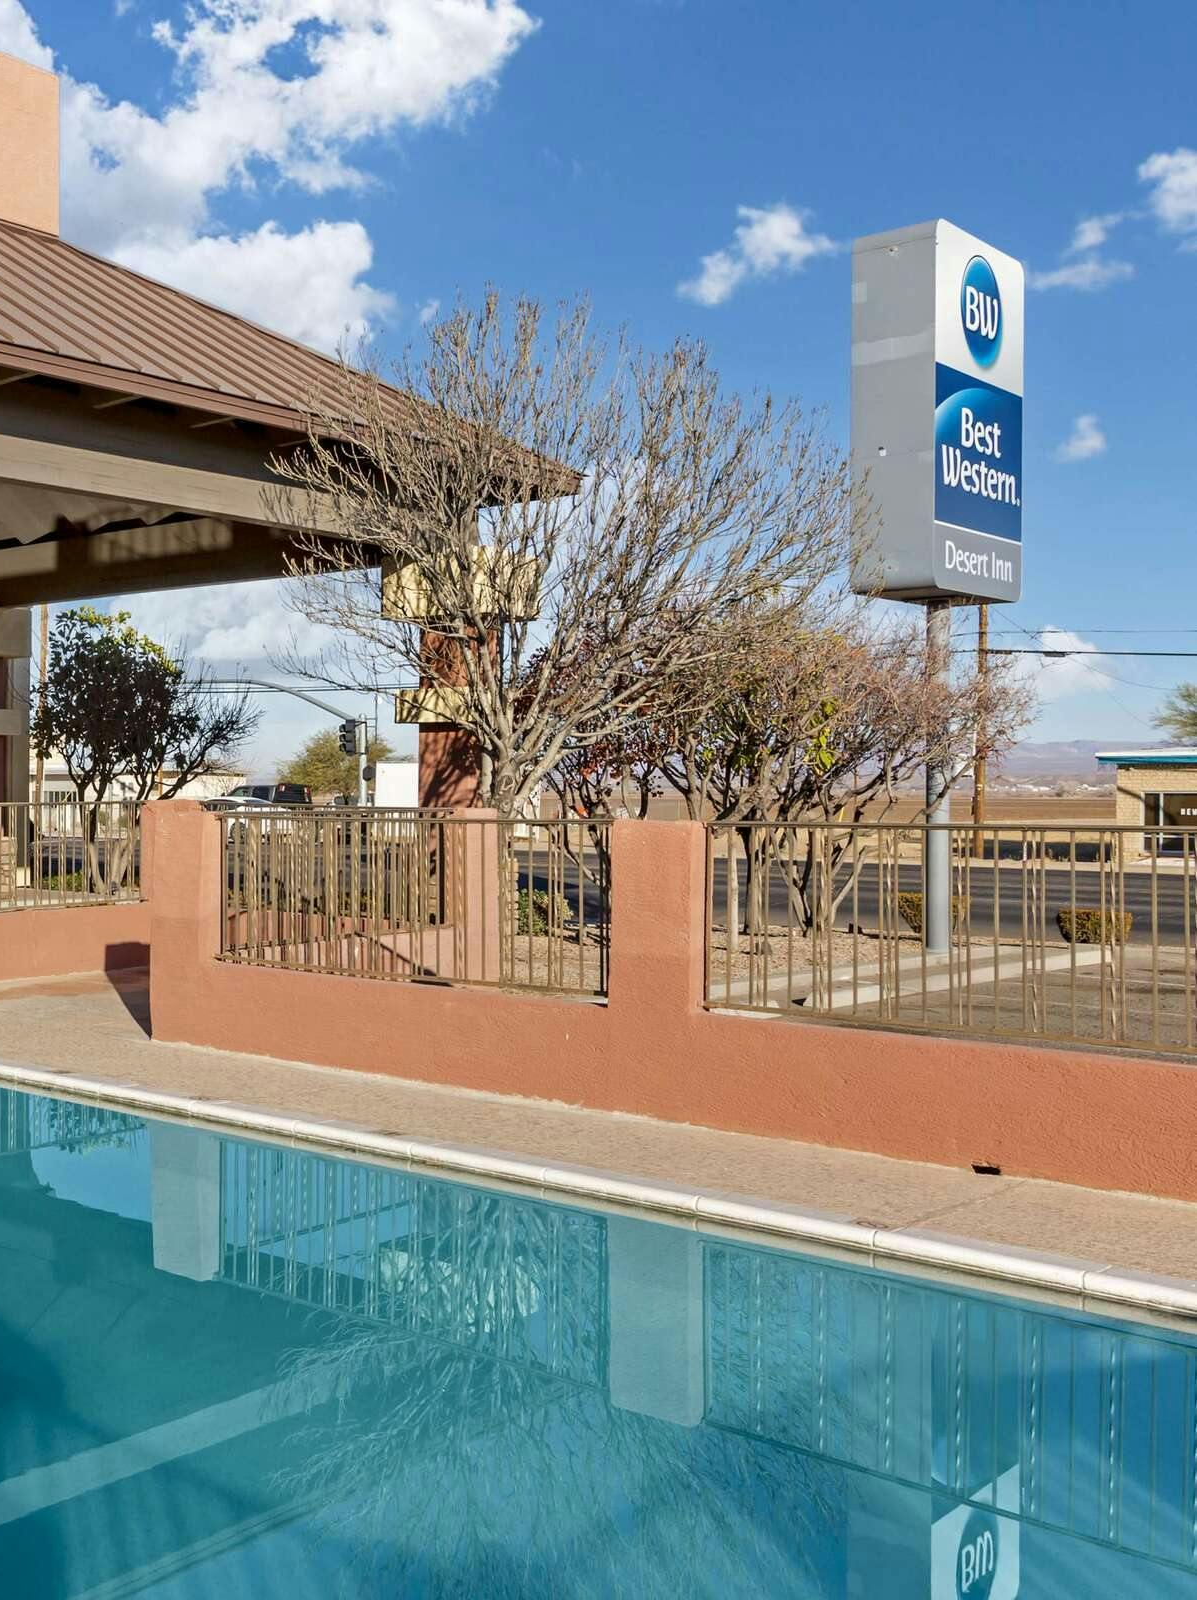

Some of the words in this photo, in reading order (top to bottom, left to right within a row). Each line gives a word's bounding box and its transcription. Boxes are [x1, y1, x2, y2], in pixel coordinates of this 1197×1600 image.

[965, 285, 999, 341] BW
[961, 407, 1001, 459] Best
[945, 540, 989, 578] Desert
[991, 551, 1013, 583] Inn
